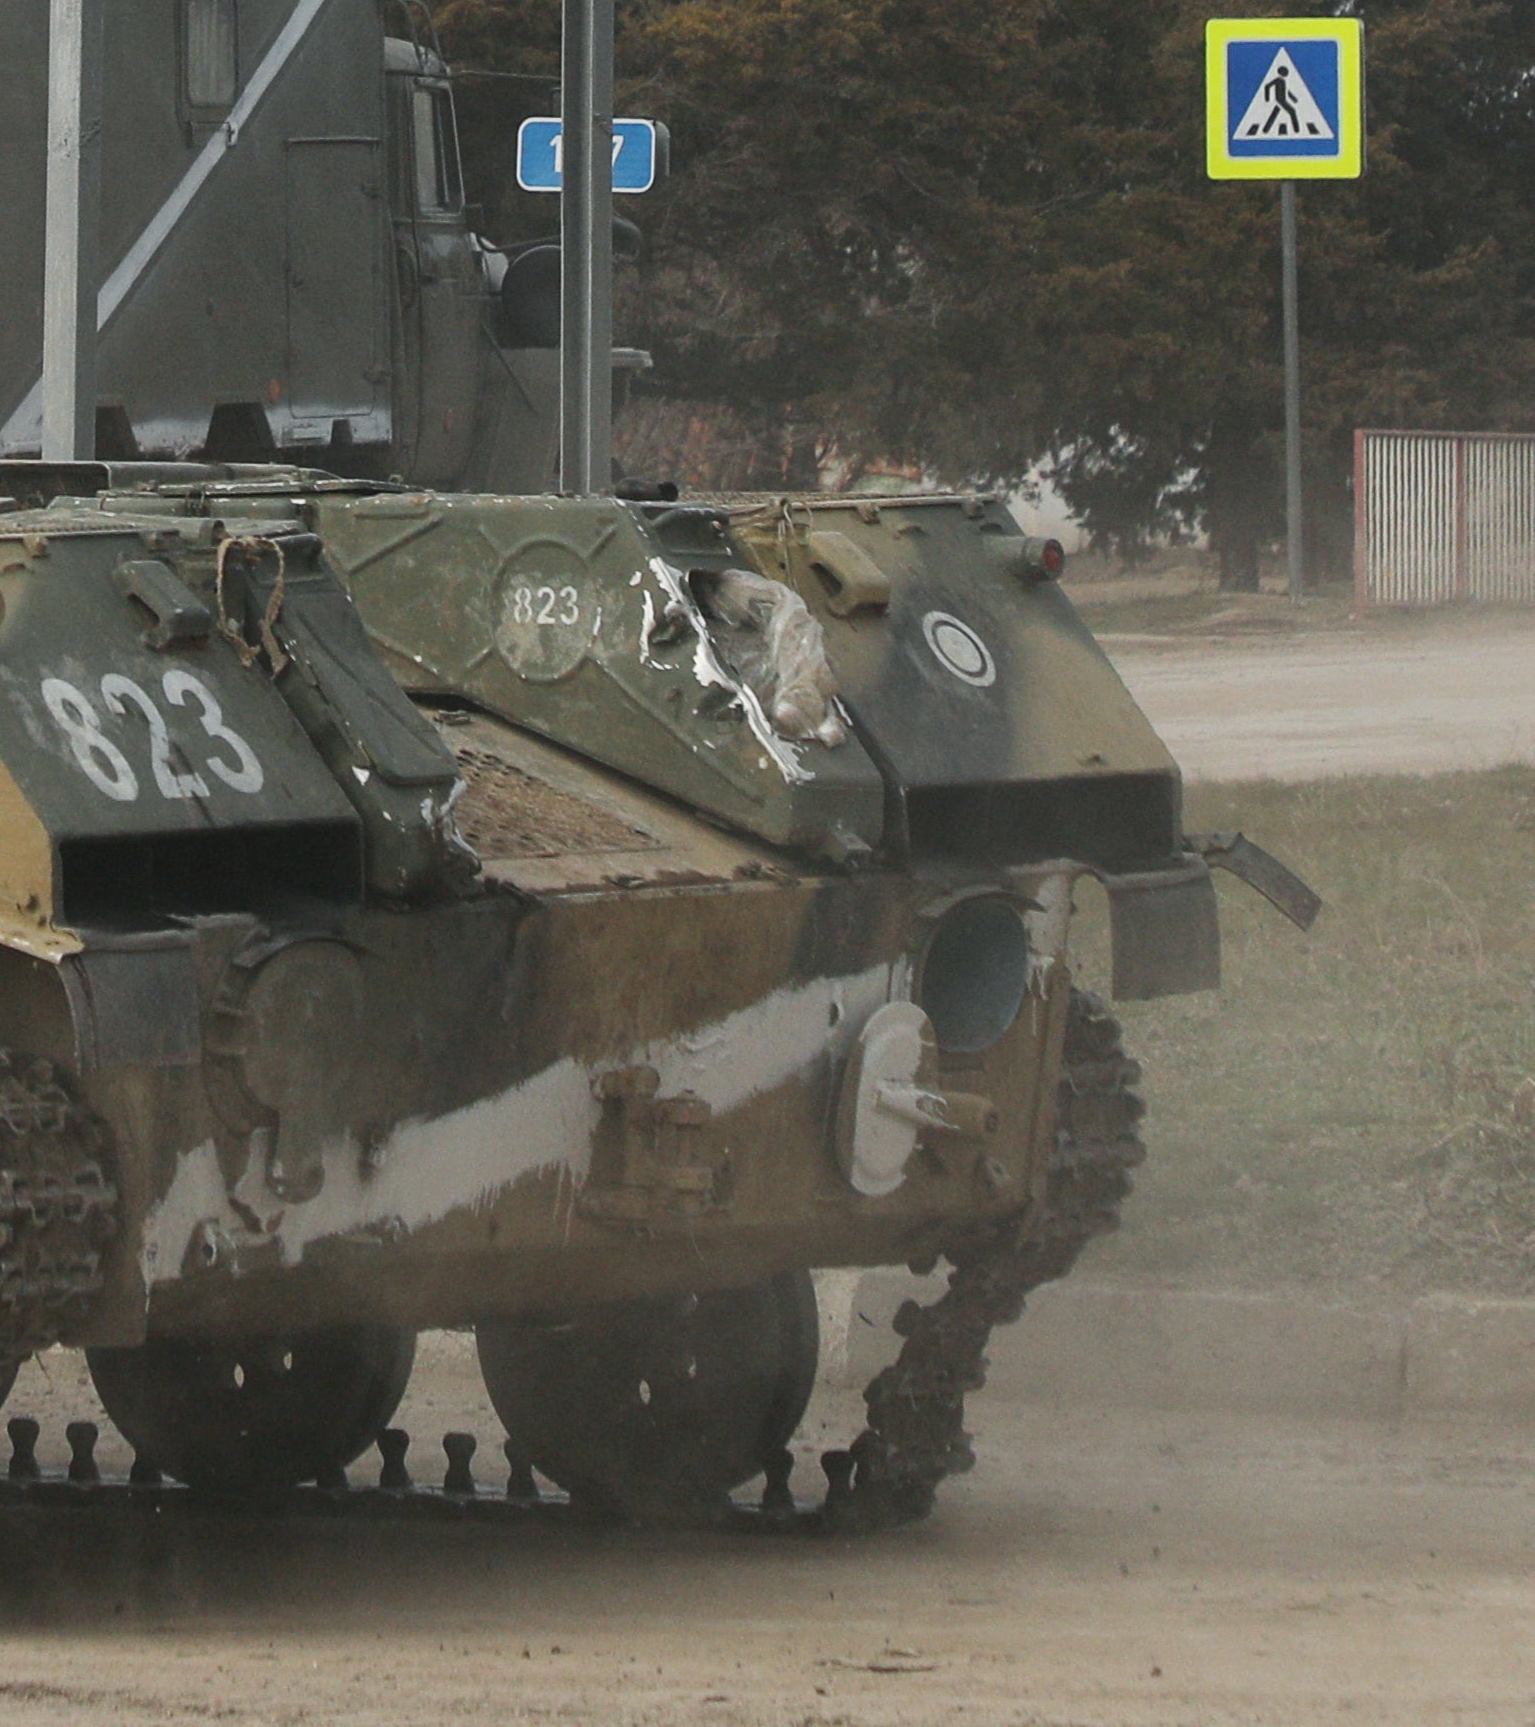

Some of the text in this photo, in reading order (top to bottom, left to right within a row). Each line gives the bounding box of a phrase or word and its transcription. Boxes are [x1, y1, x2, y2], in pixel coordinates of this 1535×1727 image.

[549, 134, 625, 174] 17
[513, 585, 580, 626] 823
[41, 669, 264, 801] 823
